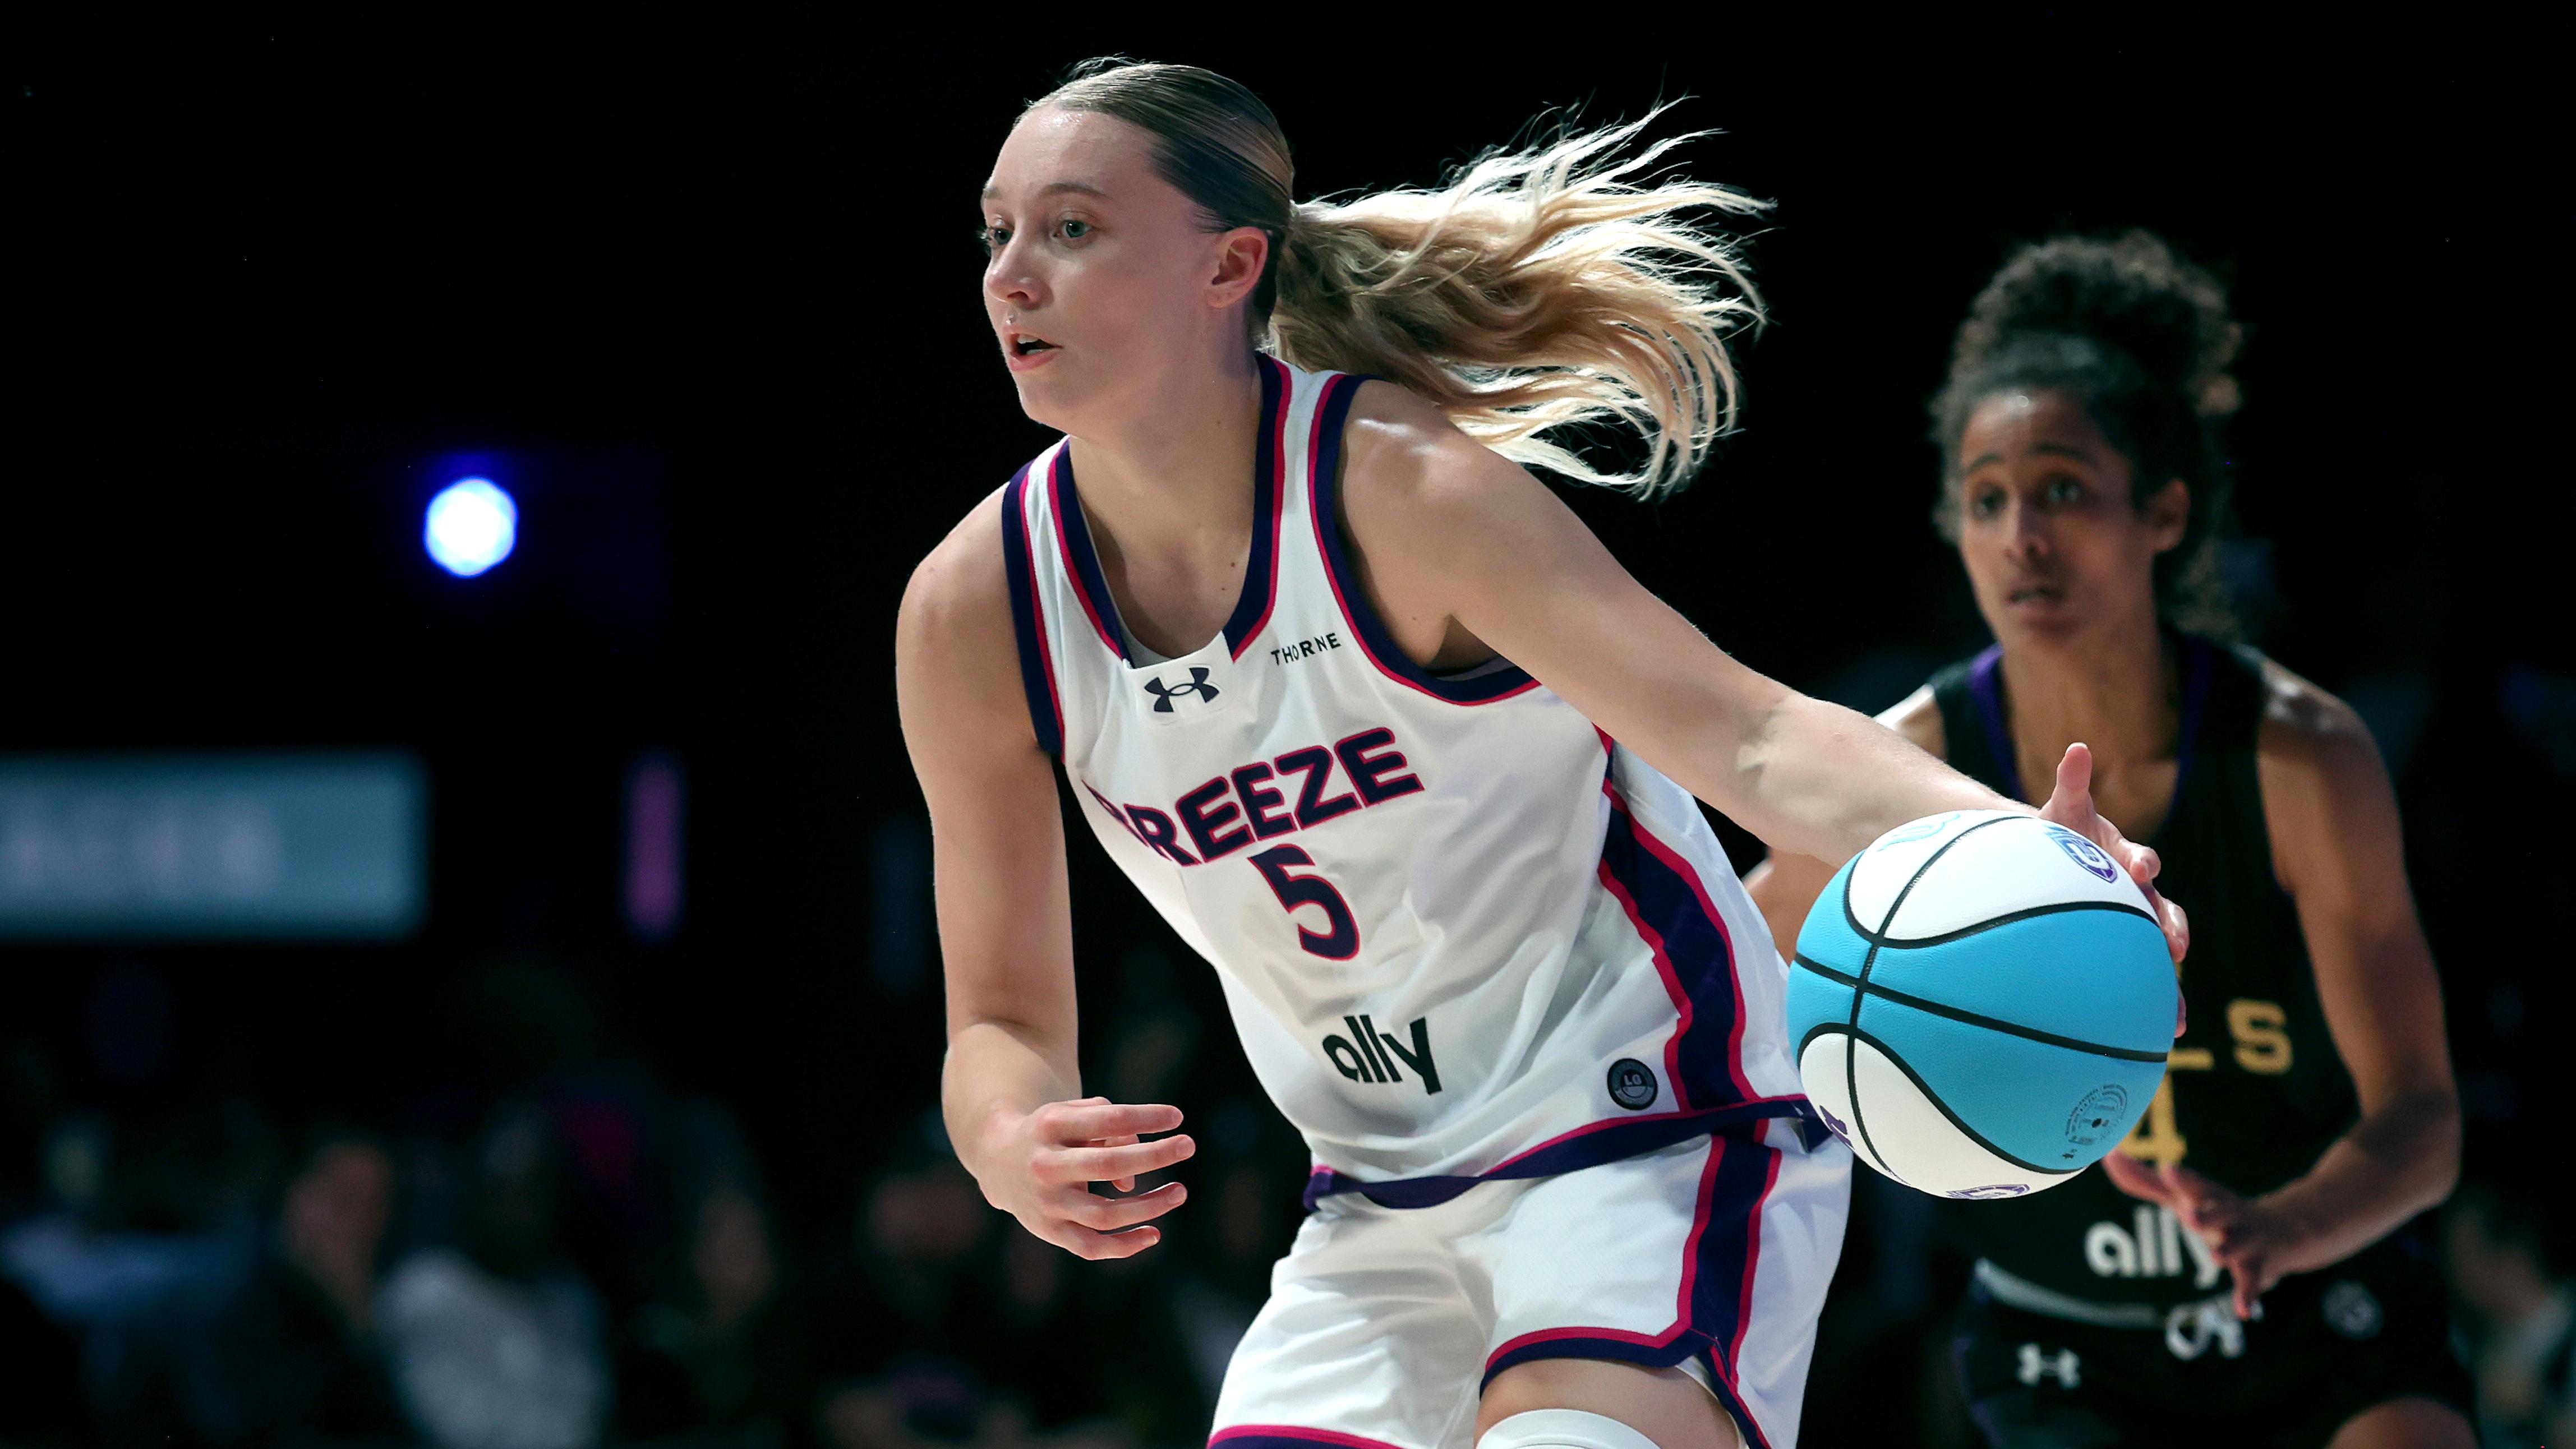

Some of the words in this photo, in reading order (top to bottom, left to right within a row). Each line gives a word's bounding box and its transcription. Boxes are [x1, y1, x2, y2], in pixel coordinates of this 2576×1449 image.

[1271, 633, 1342, 666] THORNE
[1248, 843, 1361, 961] 5
[1322, 1014, 1443, 1095] ally
[2084, 1204, 2222, 1290] ally
